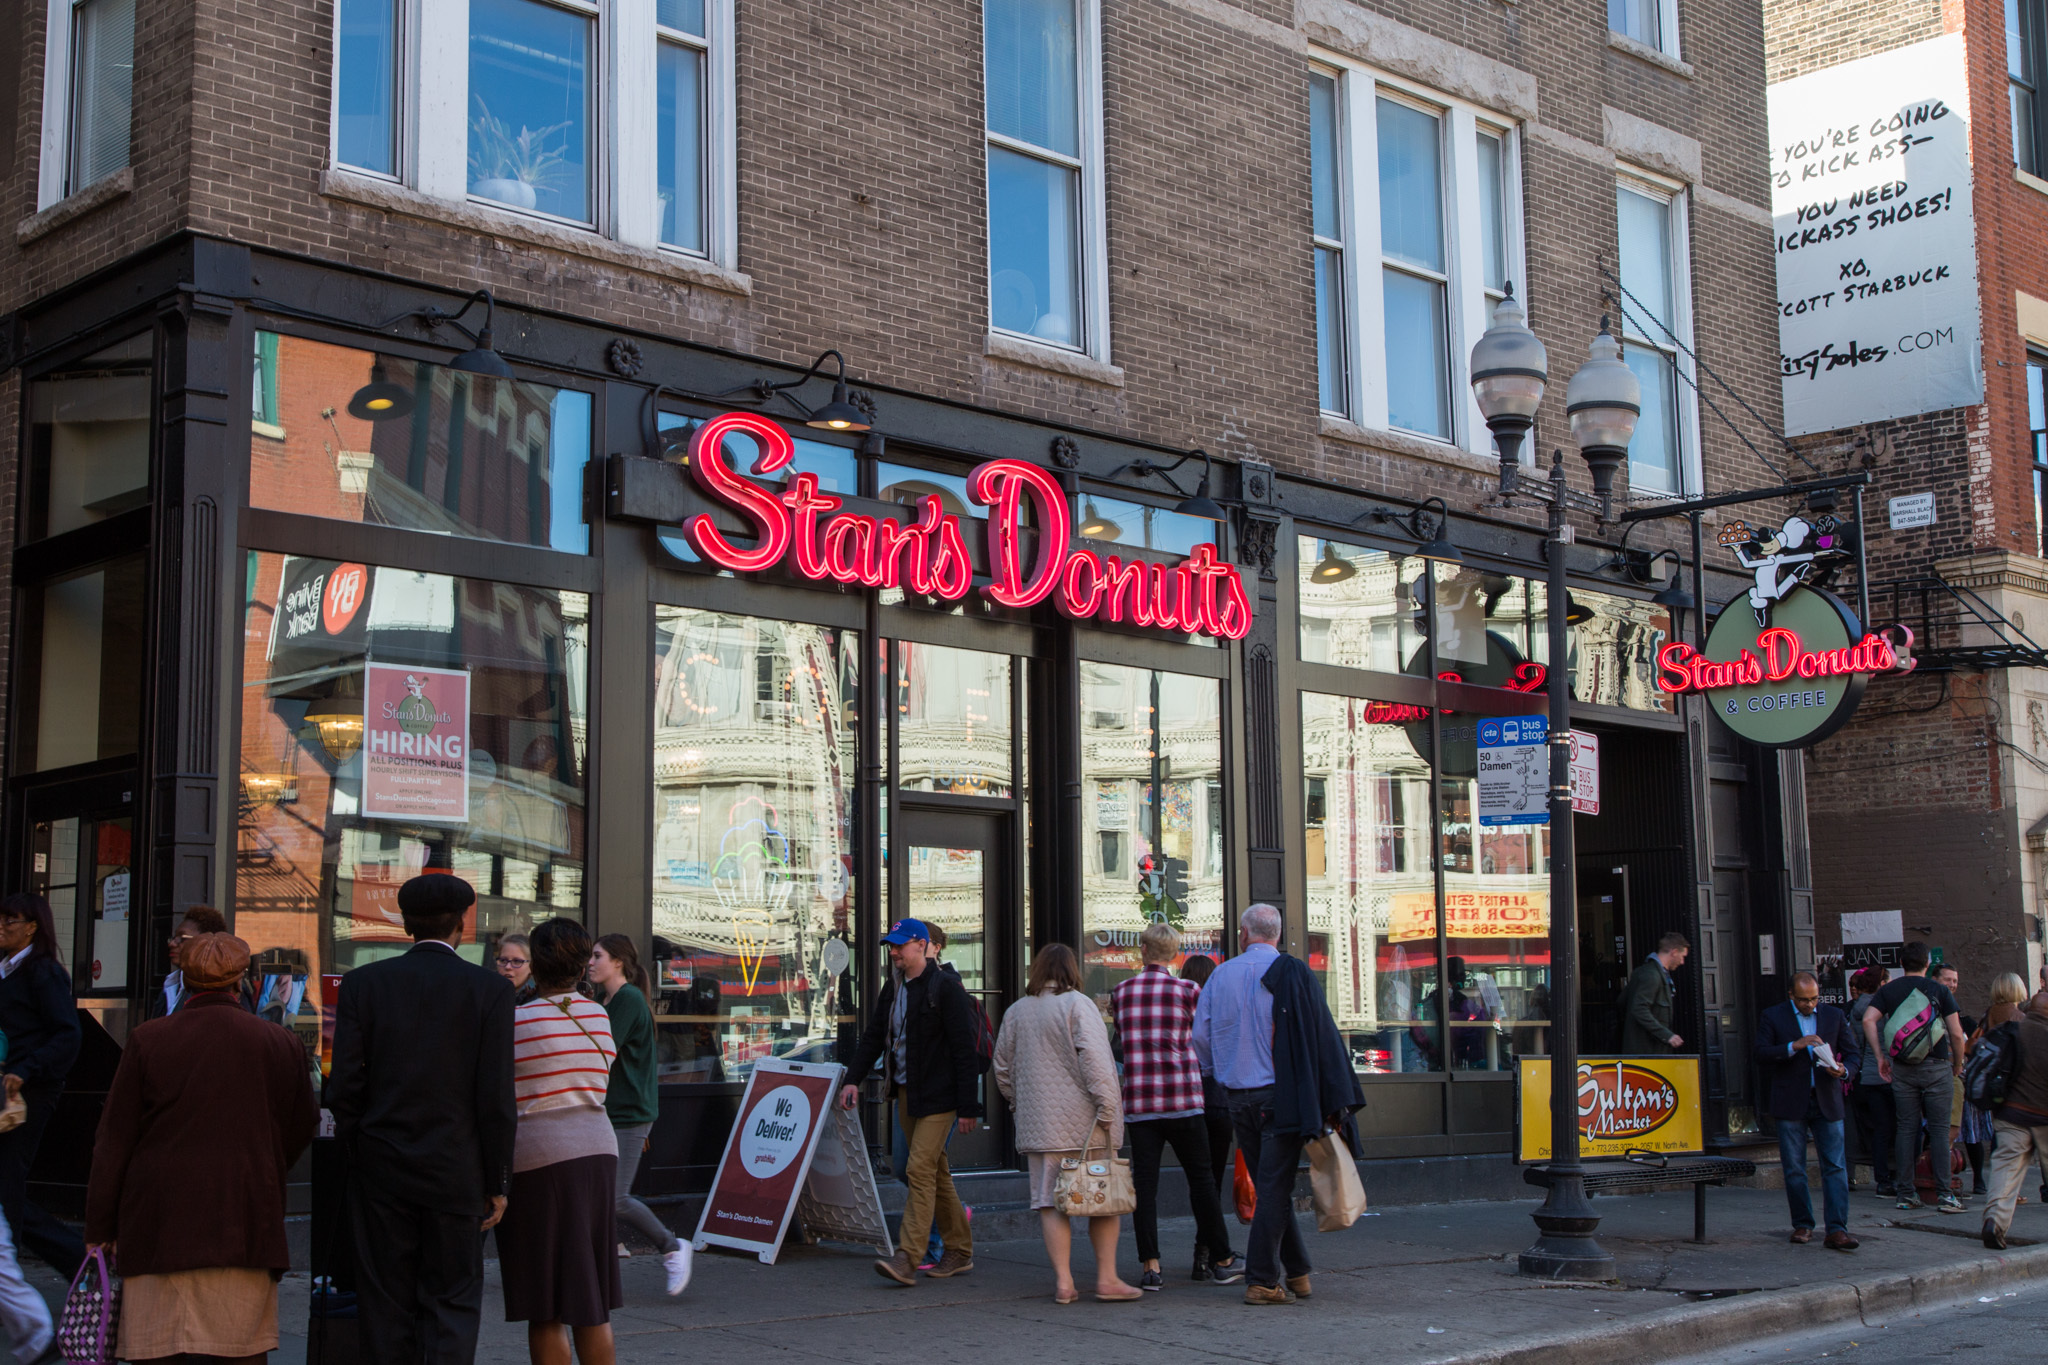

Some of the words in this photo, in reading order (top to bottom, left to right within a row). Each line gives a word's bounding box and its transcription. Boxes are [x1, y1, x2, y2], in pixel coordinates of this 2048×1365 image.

[1784, 128, 1860, 163] YOU'RE
[1869, 101, 1950, 138] GOING
[1802, 151, 1860, 182] KICK
[1797, 197, 1838, 225] YOU
[1848, 180, 1908, 209] NEED
[1775, 215, 1861, 254] ICKASS
[1866, 187, 1952, 230] SHOES!
[1839, 258, 1871, 281] XO,
[1843, 265, 1950, 303] STARBUCK
[1896, 499, 1919, 508] MANAGED
[683, 411, 972, 600] Stan's
[966, 458, 1254, 641] Donuts
[1658, 641, 1762, 694] Stan's
[1757, 627, 1894, 682] Donuts
[382, 701, 414, 721] Stan's
[414, 703, 451, 723] Donuts
[1726, 698, 1738, 714] &
[1747, 690, 1826, 712] COFFEE
[1484, 729, 1498, 737] cta
[1522, 719, 1541, 730] bus
[371, 729, 462, 758] HIRING
[1522, 730, 1545, 742] stop
[370, 756, 386, 764] ALL
[440, 760, 462, 770] PLUS
[1480, 752, 1491, 761] 50
[370, 766, 397, 774] HOURLY
[418, 770, 462, 778] SUPERVISORS
[1480, 762, 1513, 772] Damen
[1579, 769, 1591, 784] BUS
[1579, 784, 1594, 797] STOP
[1580, 800, 1596, 812] ZONE
[1847, 946, 1900, 966] JANET
[1577, 1061, 1675, 1116] Sultan's
[774, 1098, 793, 1118] We
[755, 1118, 798, 1142] Deliver!
[1587, 1109, 1651, 1142] Market
[1663, 1141, 1678, 1149] North
[716, 1209, 734, 1220] Stan's
[733, 1212, 753, 1223] Donuts
[753, 1215, 774, 1226] Damen
